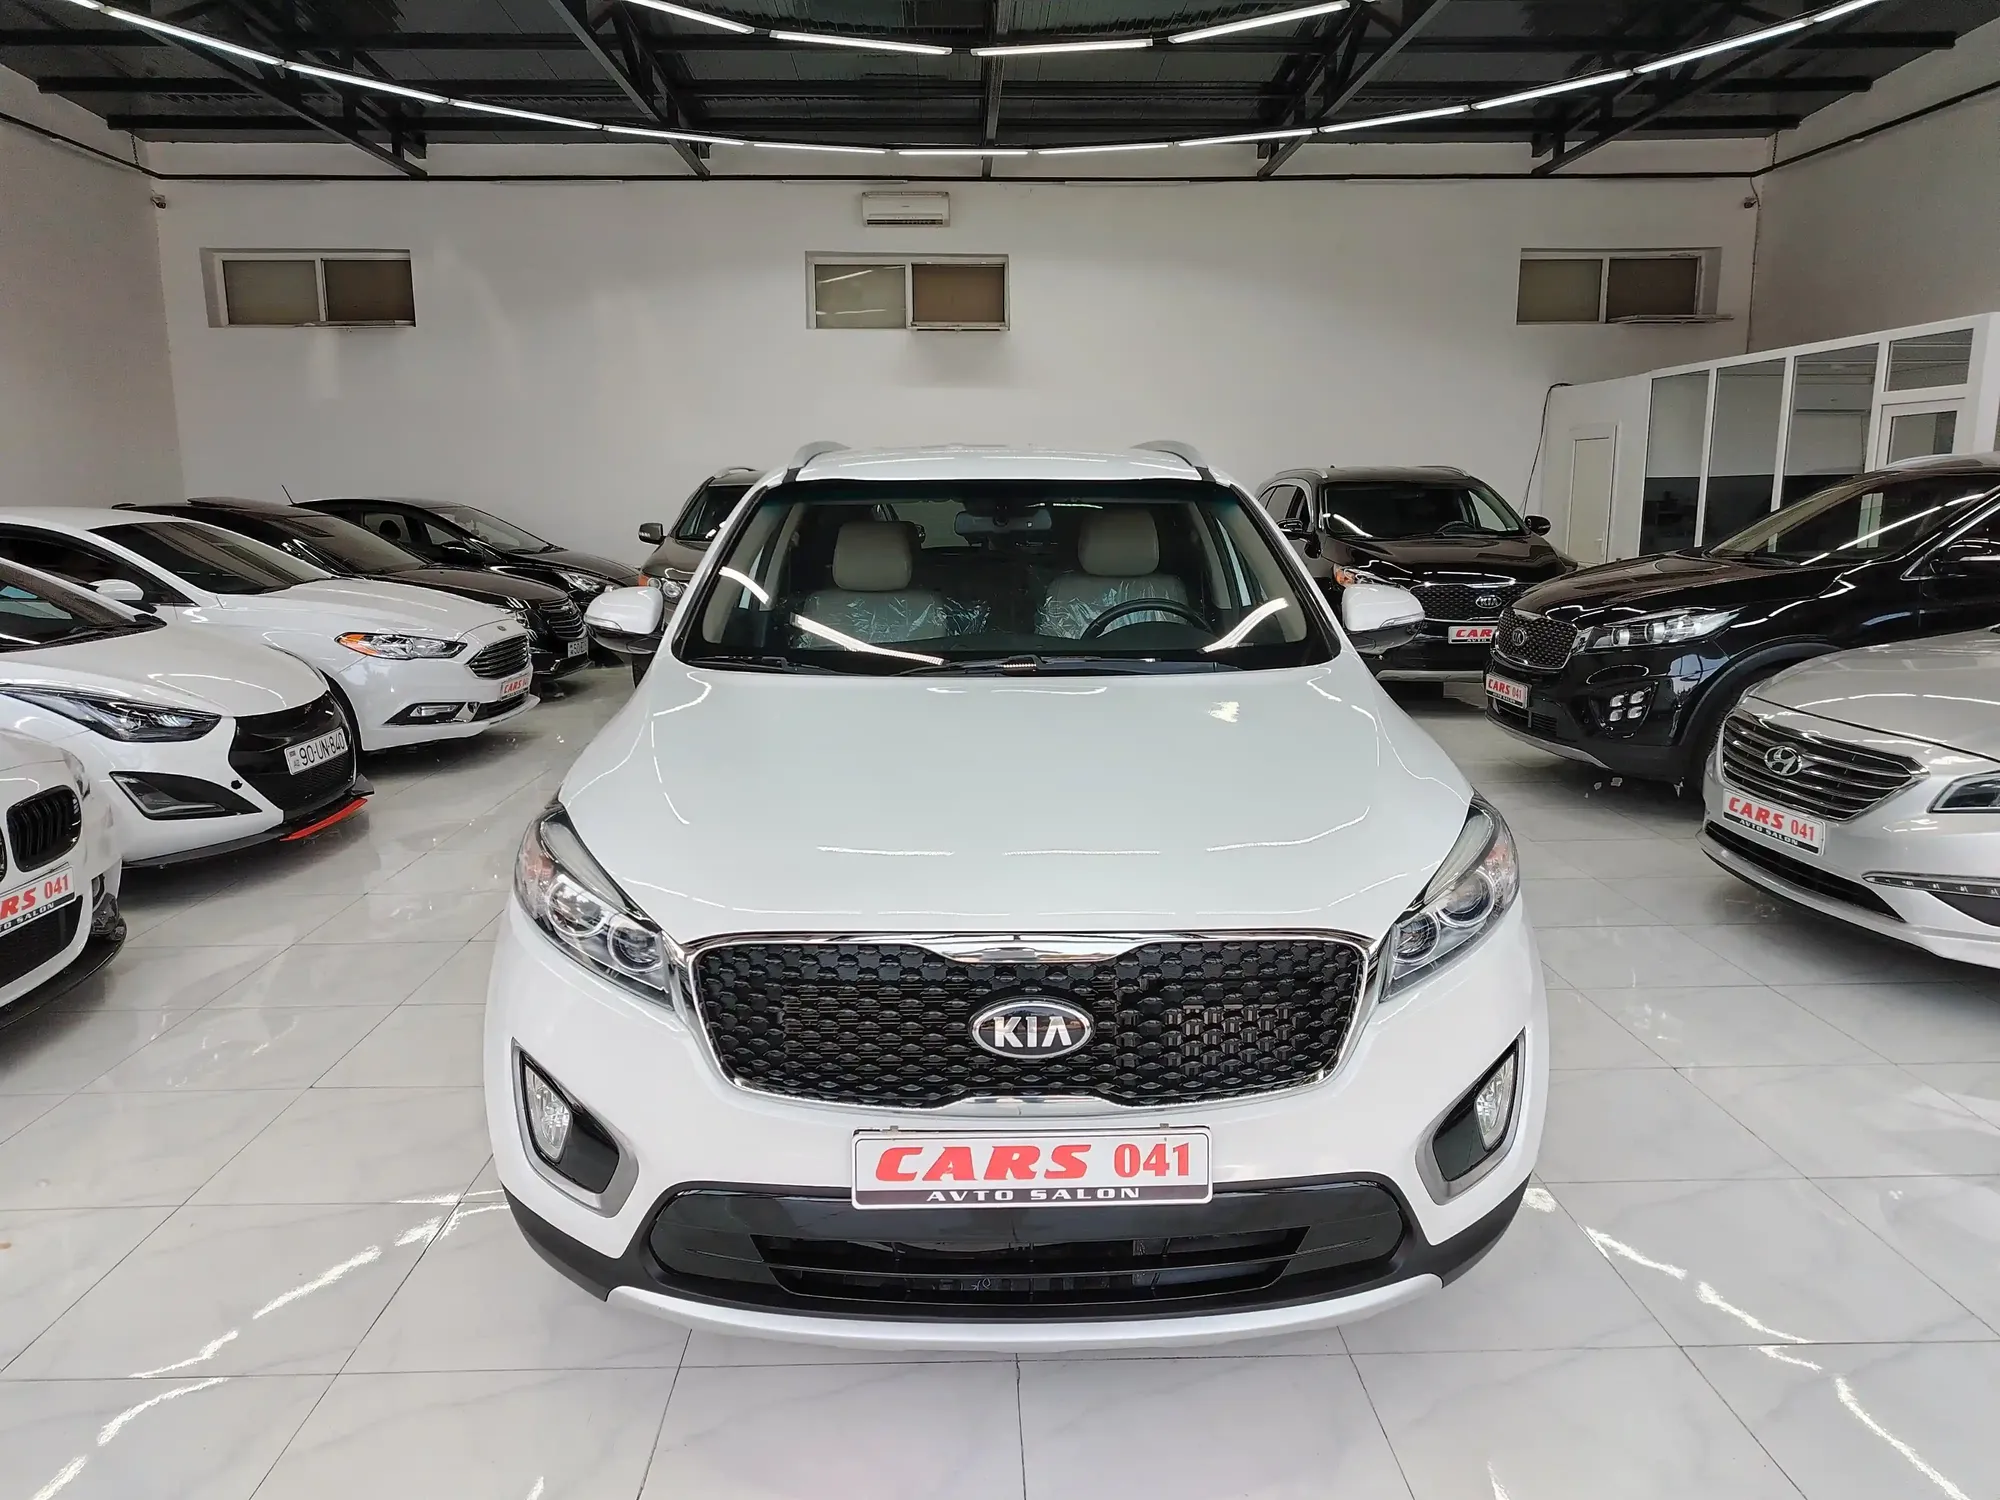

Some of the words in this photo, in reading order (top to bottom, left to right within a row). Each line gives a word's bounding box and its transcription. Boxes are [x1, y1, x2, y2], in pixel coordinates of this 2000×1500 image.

[1456, 629, 1492, 638] CAR
[503, 679, 524, 694] CARS
[1488, 679, 1511, 696] CARS
[1728, 797, 1785, 830] CARS
[1791, 819, 1814, 841] 041
[1740, 819, 1763, 832] AVTO
[1766, 828, 1798, 846] SALON
[0, 887, 36, 920] RS
[44, 874, 69, 899] 041
[16, 902, 55, 923] SALON
[993, 1016, 1072, 1048] KIA
[875, 1144, 1092, 1182] CARS
[1113, 1142, 1190, 1178] 041
[926, 1190, 1014, 1202] AVTO
[1030, 1187, 1140, 1200] SALON
